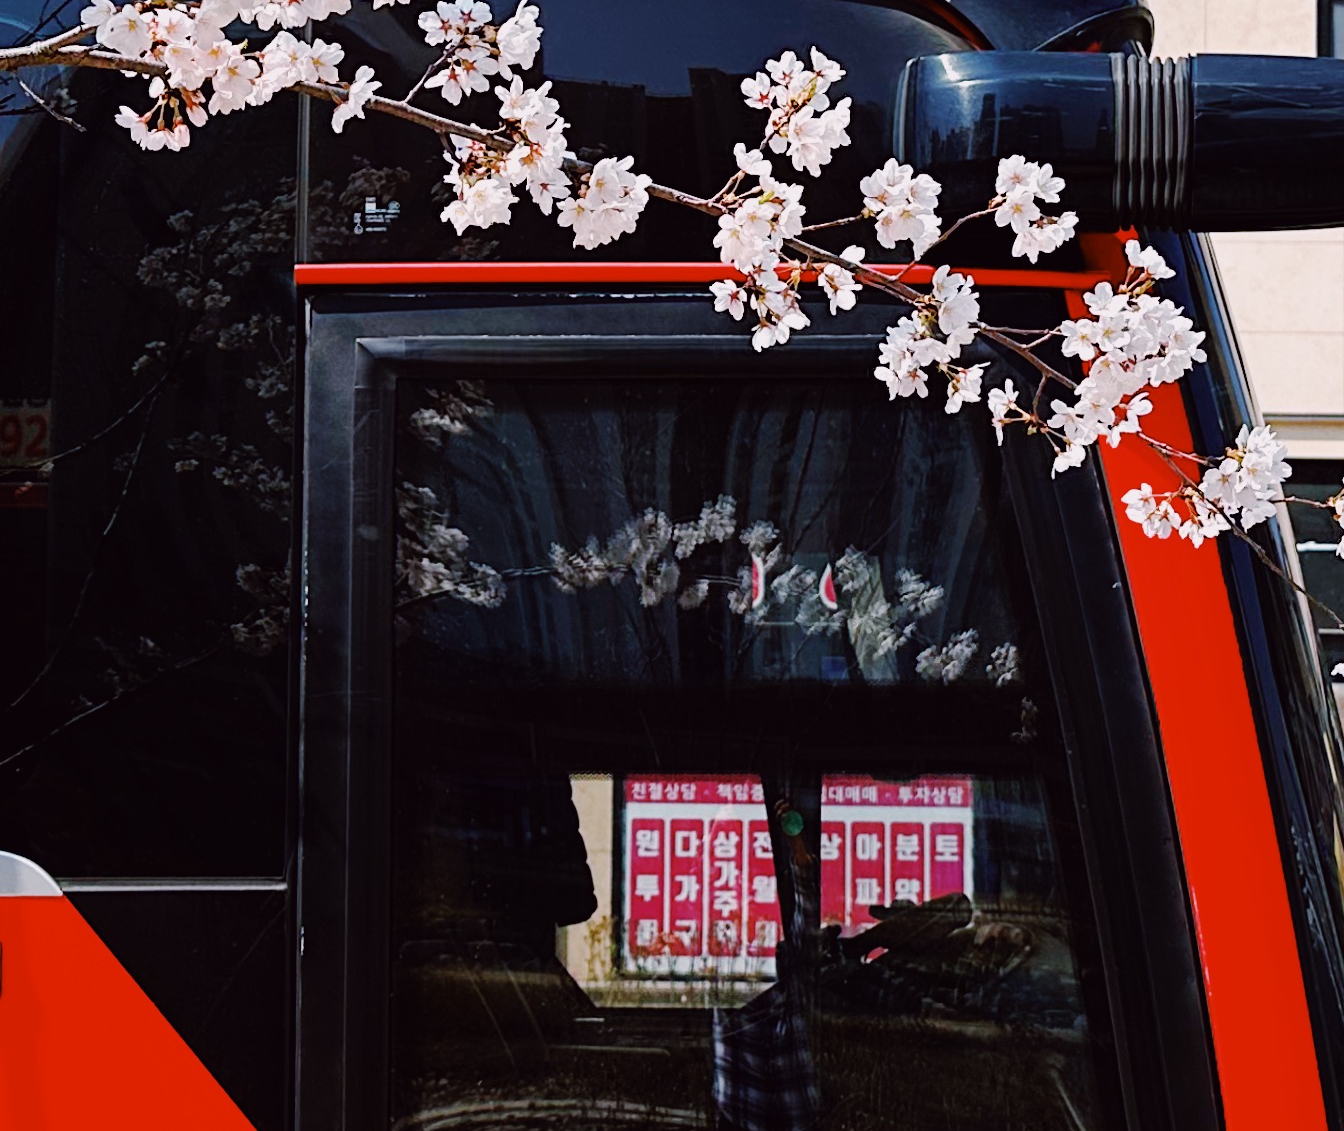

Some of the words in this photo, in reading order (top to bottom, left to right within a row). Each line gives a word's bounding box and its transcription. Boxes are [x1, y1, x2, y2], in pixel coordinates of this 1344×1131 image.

[631, 781, 697, 801] 친절상담
[821, 784, 878, 804] 대매매
[898, 785, 963, 805] 투자상담
[673, 830, 701, 948] 다가구
[855, 833, 882, 930] 아파
